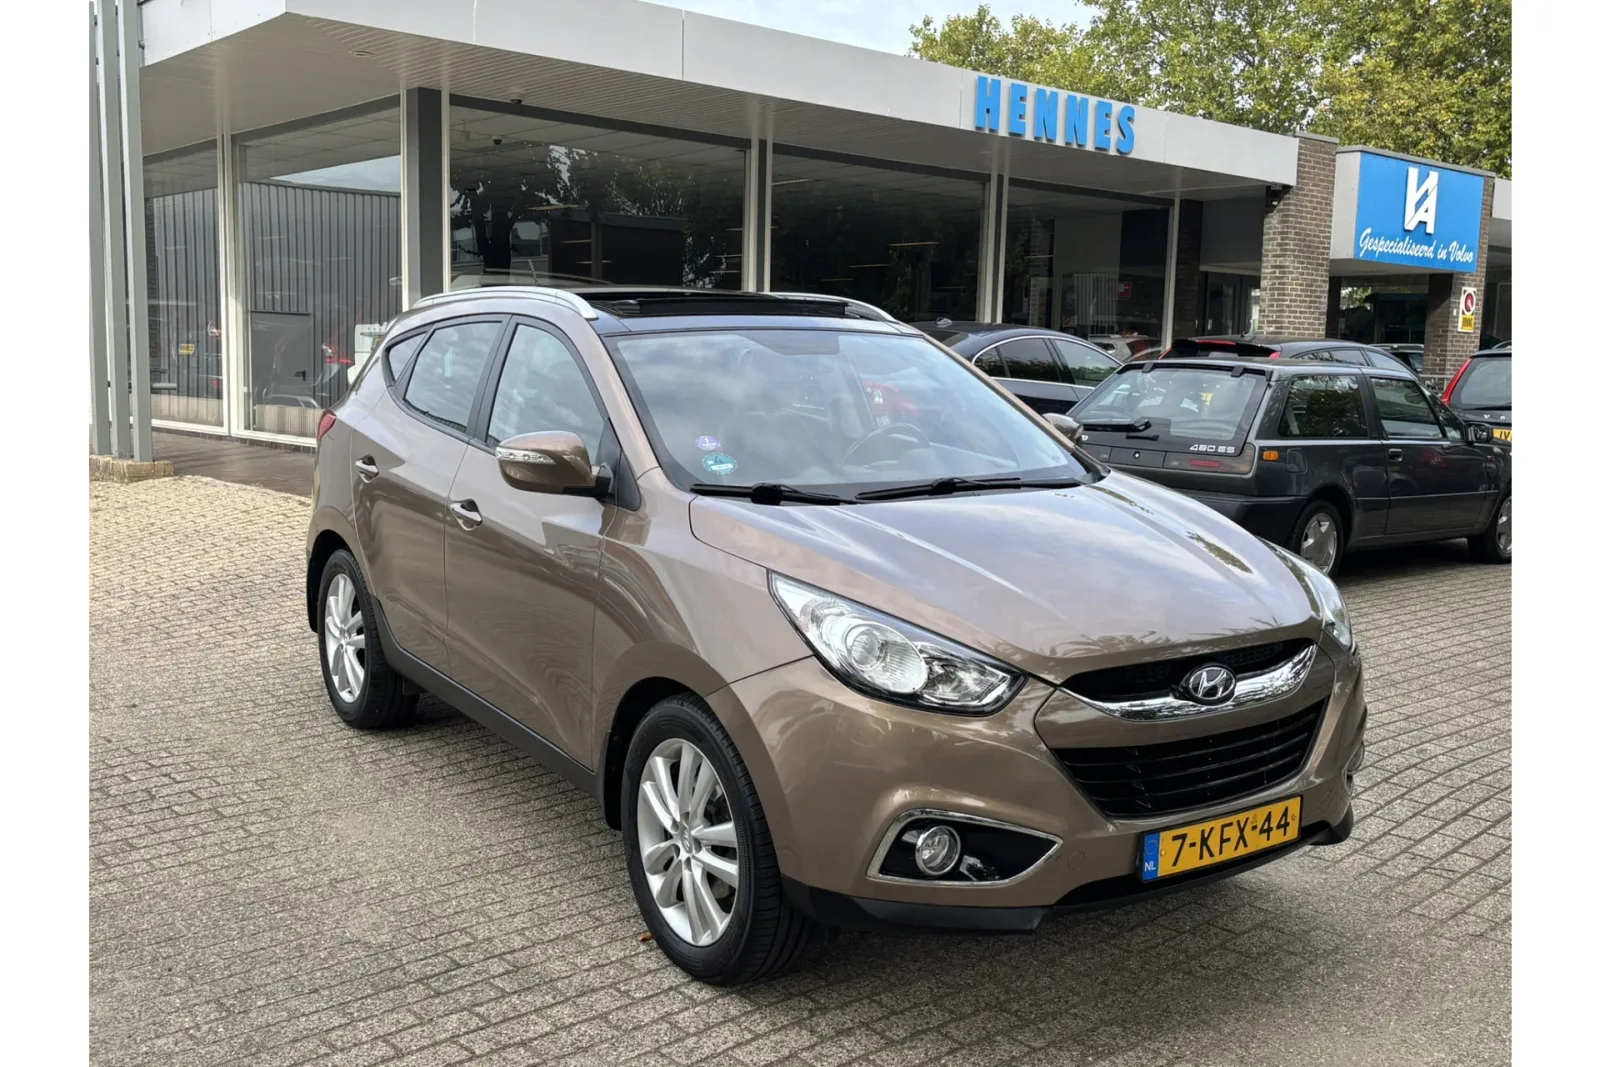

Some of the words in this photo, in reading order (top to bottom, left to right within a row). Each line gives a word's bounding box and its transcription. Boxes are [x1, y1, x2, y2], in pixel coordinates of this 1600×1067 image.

[975, 75, 1135, 155] HENNES
[1359, 227, 1436, 259] Gespecialiseerd
[1437, 243, 1448, 260] in
[1448, 241, 1474, 263] Volvo
[1190, 444, 1216, 452] 480
[1218, 446, 1235, 454] ES
[1171, 806, 1290, 867] 7-KFX-44
[1144, 861, 1156, 872] NL
